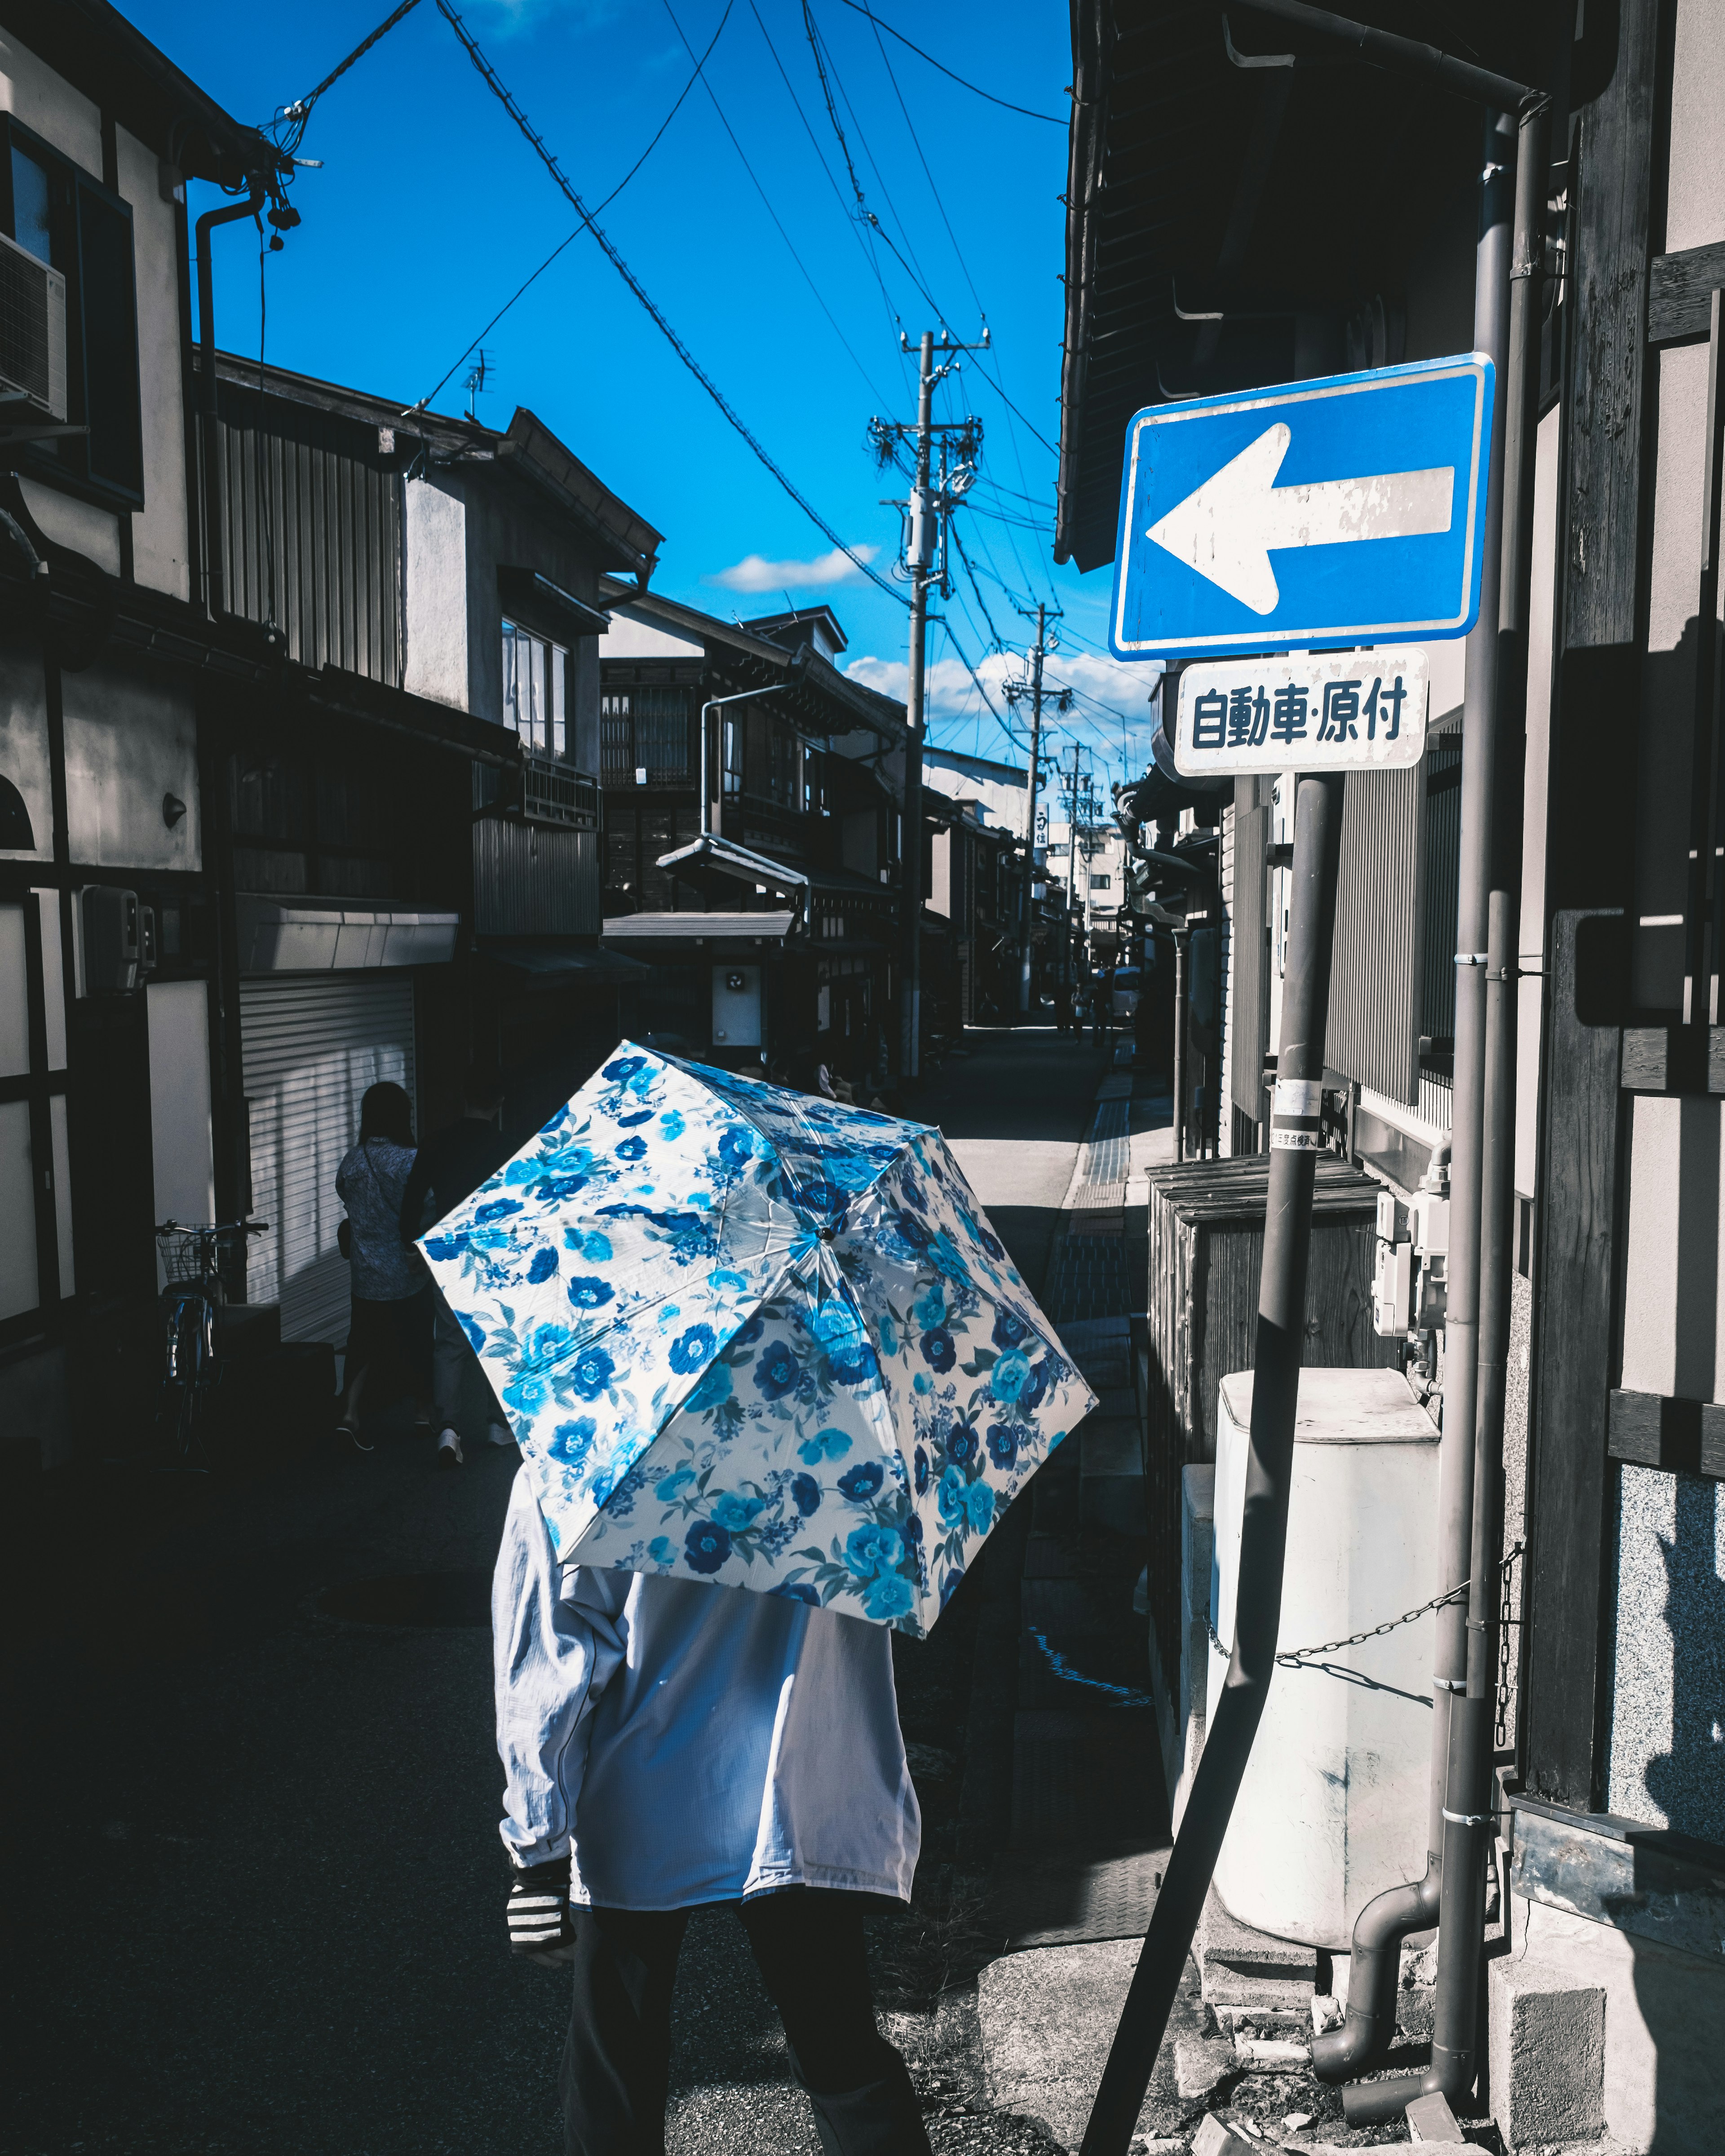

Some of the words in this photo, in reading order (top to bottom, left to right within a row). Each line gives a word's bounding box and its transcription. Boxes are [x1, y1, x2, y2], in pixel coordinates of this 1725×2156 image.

[1192, 676, 1407, 749] 自動車・原付
